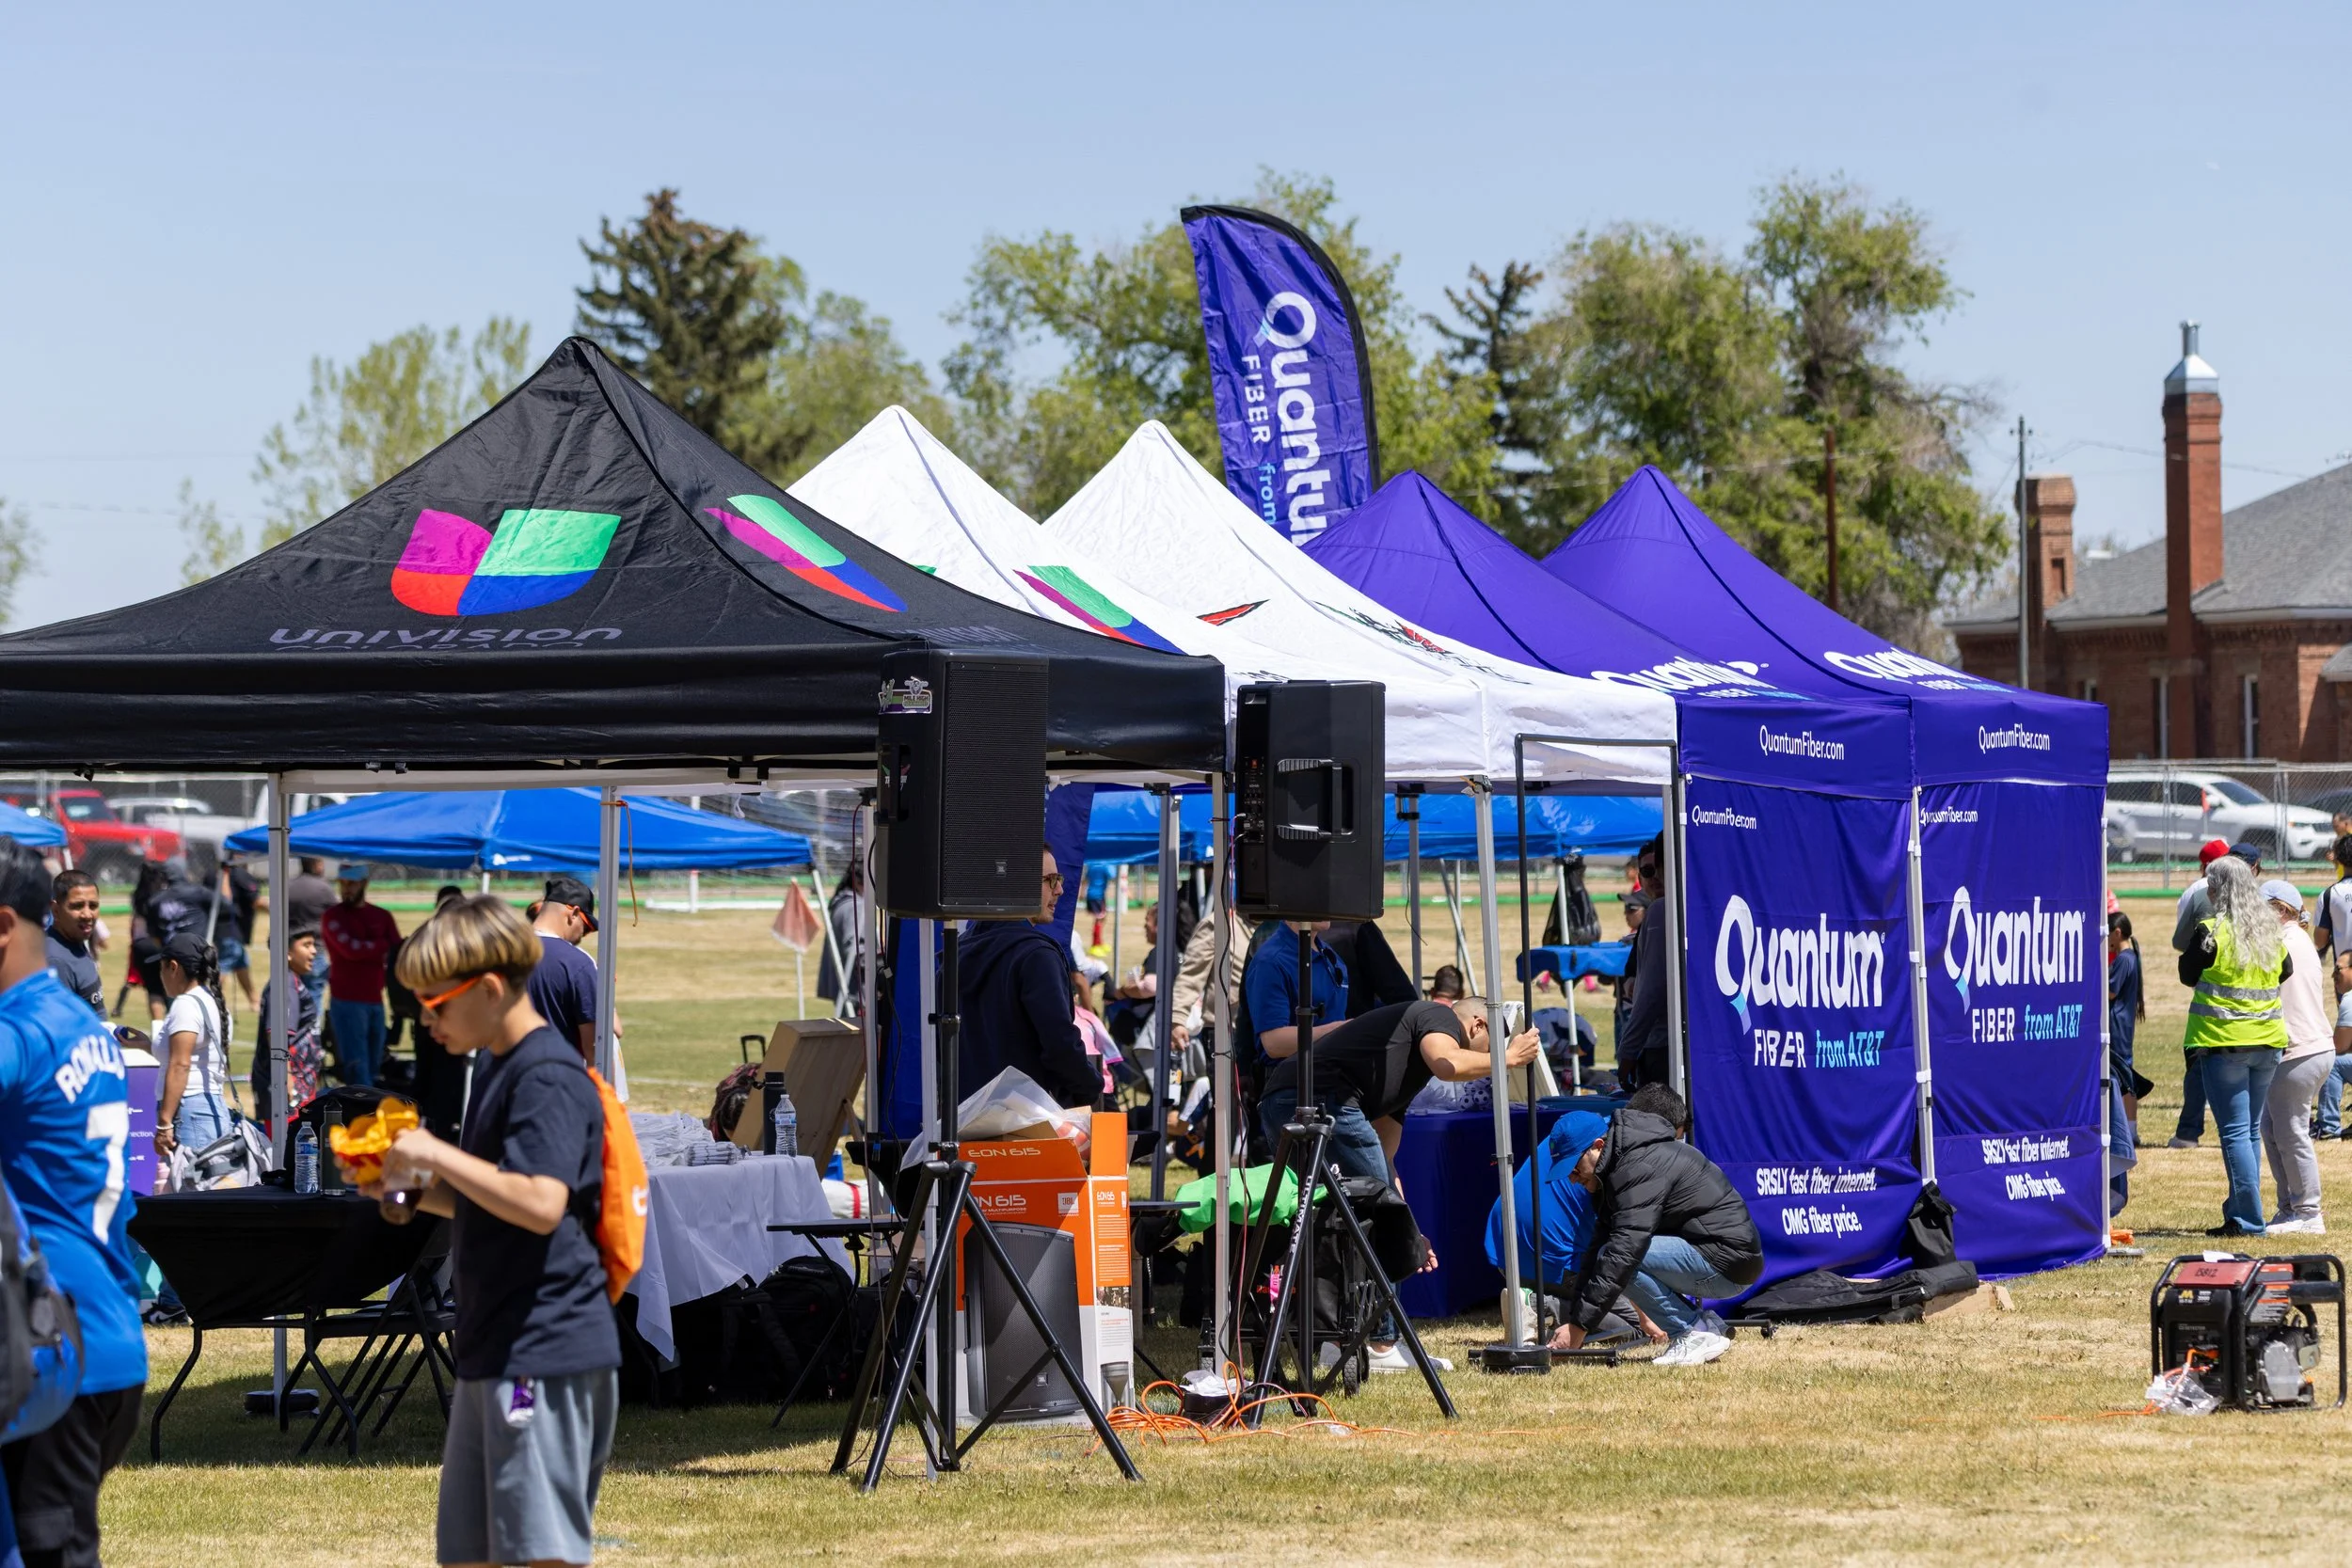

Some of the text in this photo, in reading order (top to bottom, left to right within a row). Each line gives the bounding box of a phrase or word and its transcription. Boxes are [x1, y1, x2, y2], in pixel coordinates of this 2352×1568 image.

[1253, 291, 1331, 547] Quantu
[1241, 354, 1277, 525] FIBER from
[1759, 724, 1845, 761] QuantumFiber.com
[1979, 722, 2050, 754] QuantumFiber.com
[1692, 804, 1756, 830] QuantumFber.om
[1919, 805, 1979, 828] QuumFber.com
[1715, 895, 1884, 1035] Quantum
[1944, 885, 2084, 1015] Quantum
[1972, 1004, 2083, 1043] FIBER from AT&T
[1754, 1028, 1885, 1069] FIBER from AT&T
[968, 1147, 1041, 1158] EON 615
[1981, 1134, 2070, 1164] SRSLY fast fiber internet.
[86, 1101, 130, 1246] 7
[1756, 1165, 1878, 1196] SRSLY fast fiber internet.
[2005, 1174, 2029, 1200] OMG
[2025, 1172, 2047, 1197] fiber
[995, 1194, 1026, 1207] 615
[1781, 1203, 1863, 1239] OMG fiber price.
